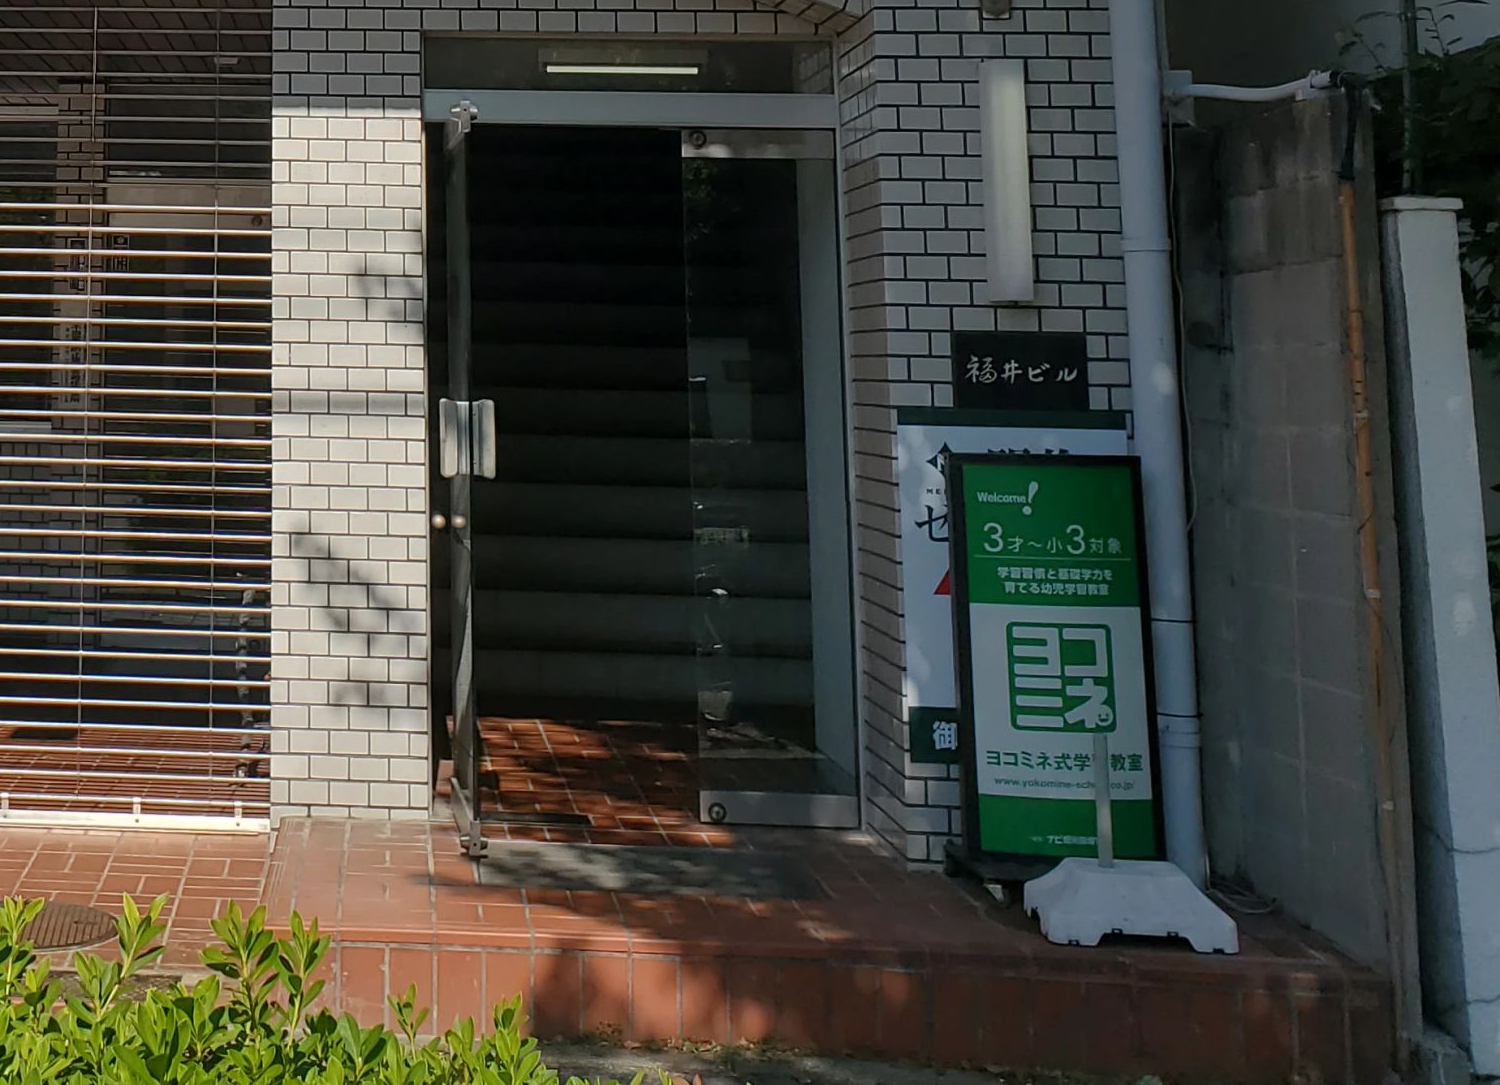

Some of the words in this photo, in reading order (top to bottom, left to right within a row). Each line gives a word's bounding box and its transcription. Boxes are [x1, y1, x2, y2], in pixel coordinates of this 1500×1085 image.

[964, 354, 1078, 386] 福井ビル
[976, 481, 1039, 515] Welcome!
[985, 750, 1144, 772] ヨコミネ式学教室
